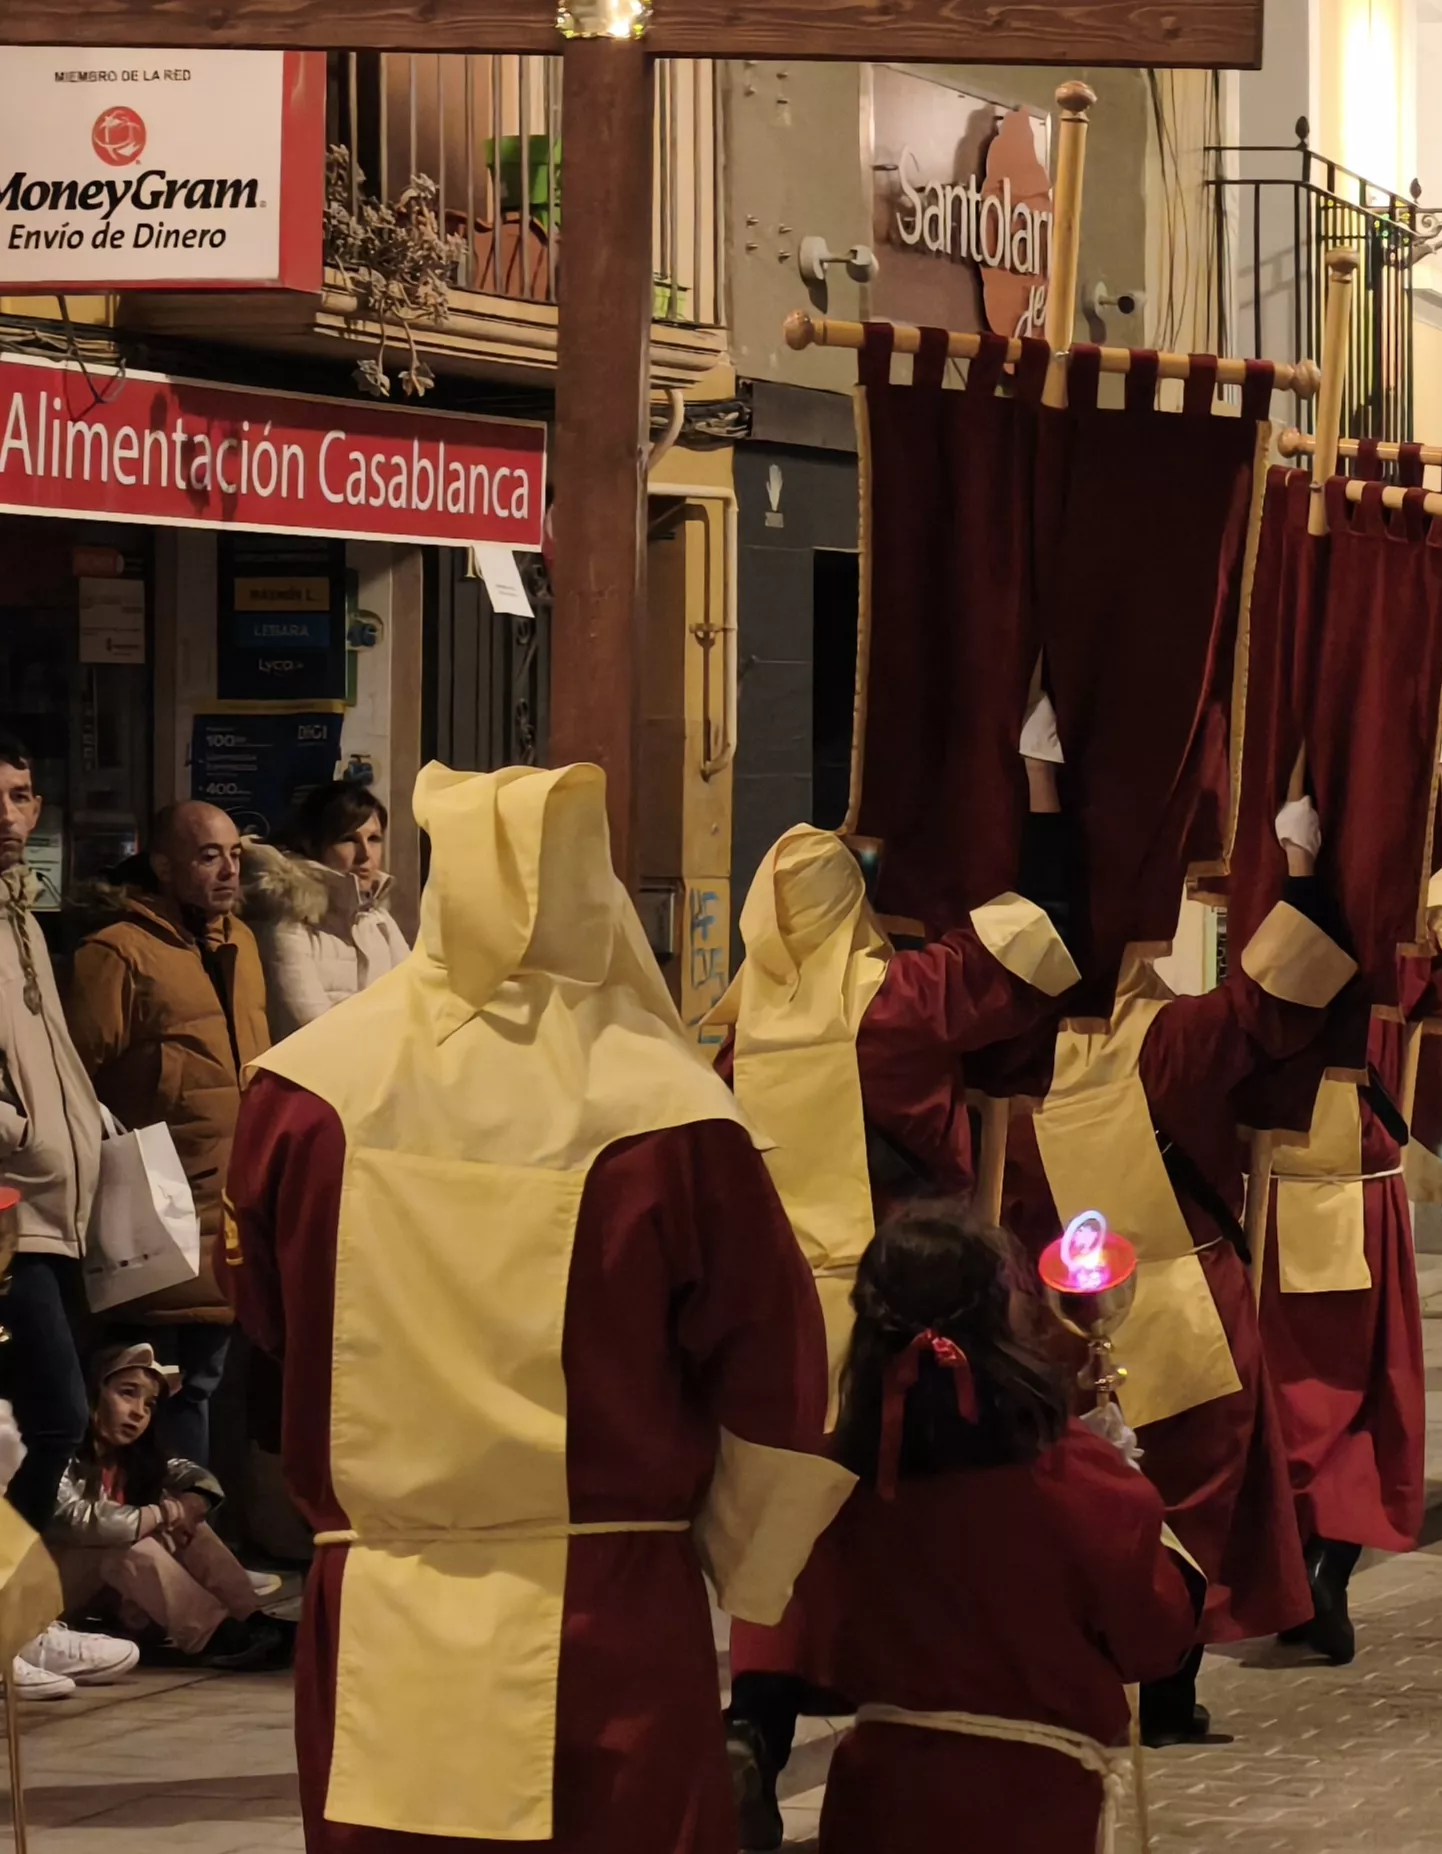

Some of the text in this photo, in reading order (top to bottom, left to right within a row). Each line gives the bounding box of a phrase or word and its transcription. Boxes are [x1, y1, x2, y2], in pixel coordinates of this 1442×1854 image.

[54, 69, 192, 83] MIEMBRO DE LA RED
[8, 221, 227, 249] Envío de Dinero
[0, 392, 530, 519] Alimentación Casablanca
